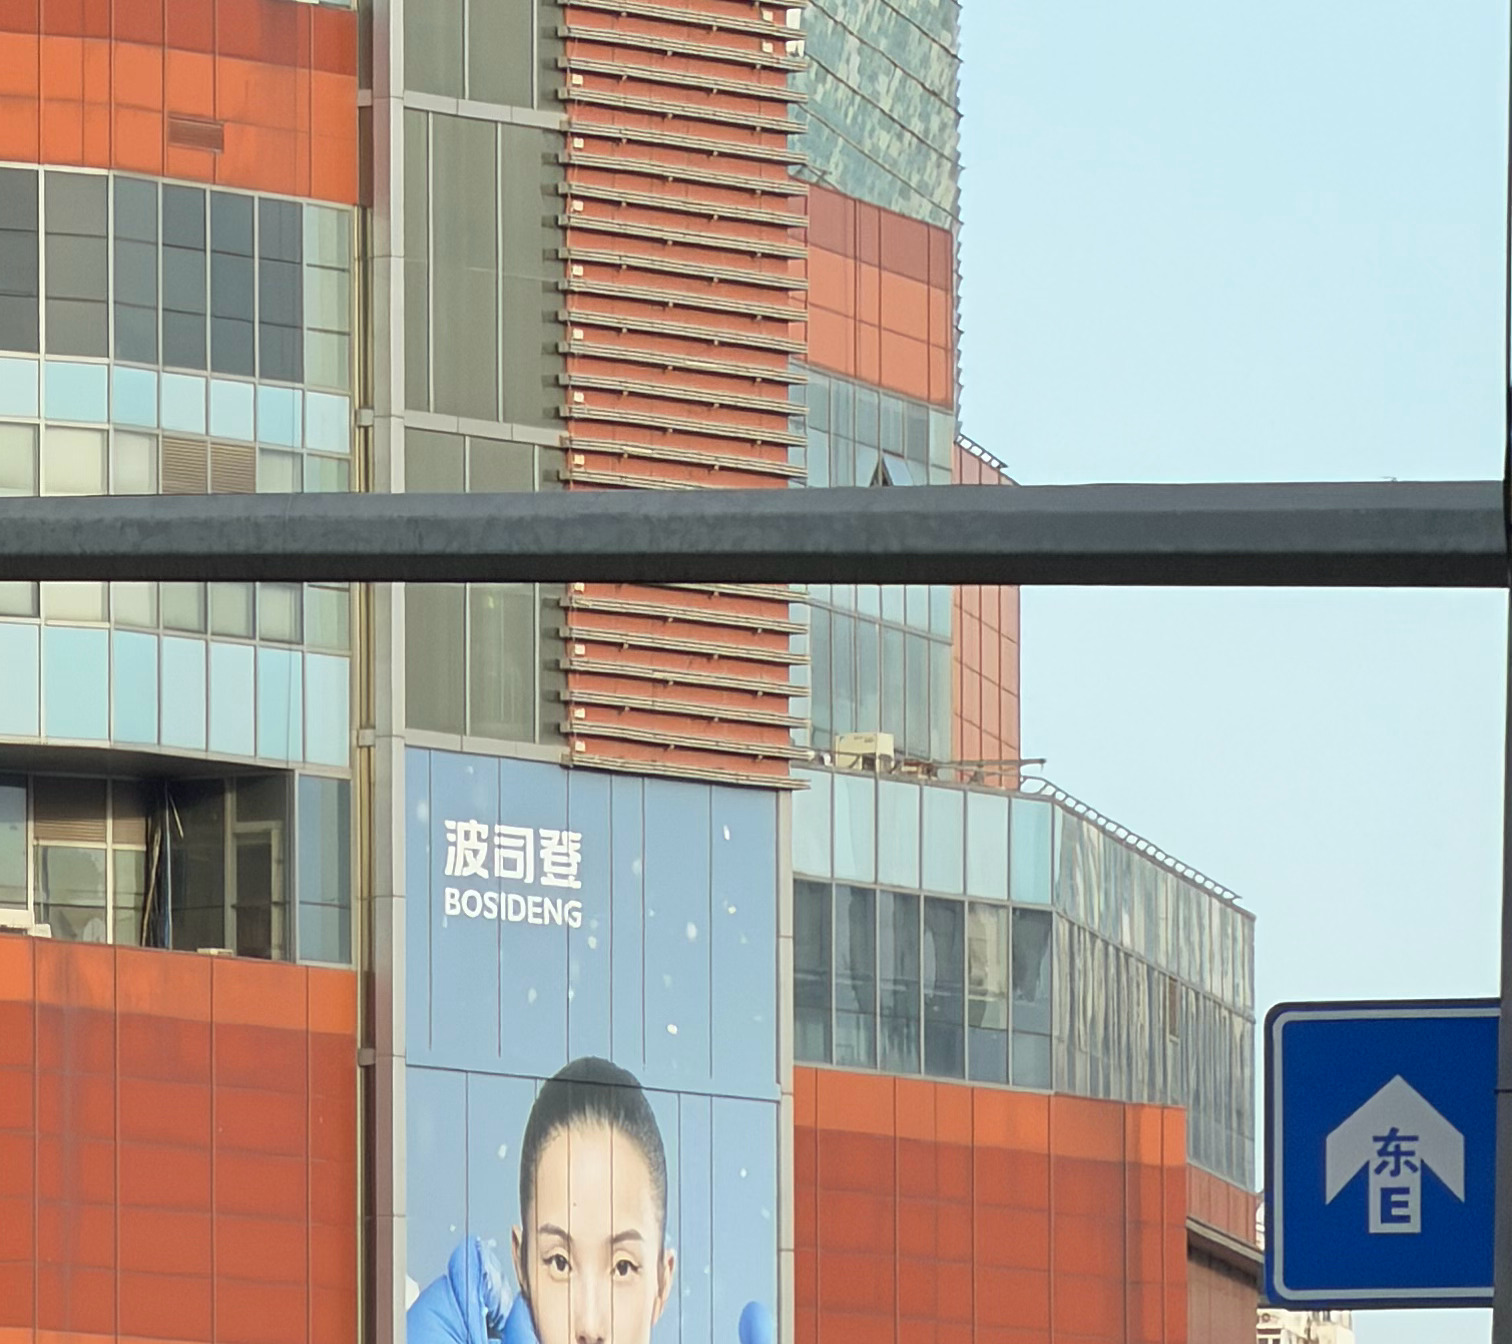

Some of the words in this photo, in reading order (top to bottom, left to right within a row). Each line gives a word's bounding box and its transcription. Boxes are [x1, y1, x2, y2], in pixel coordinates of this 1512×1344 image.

[444, 818, 583, 890] 波司登
[444, 886, 583, 929] BOSIDENG
[1372, 1126, 1419, 1177] 东
[1380, 1186, 1411, 1224] E
